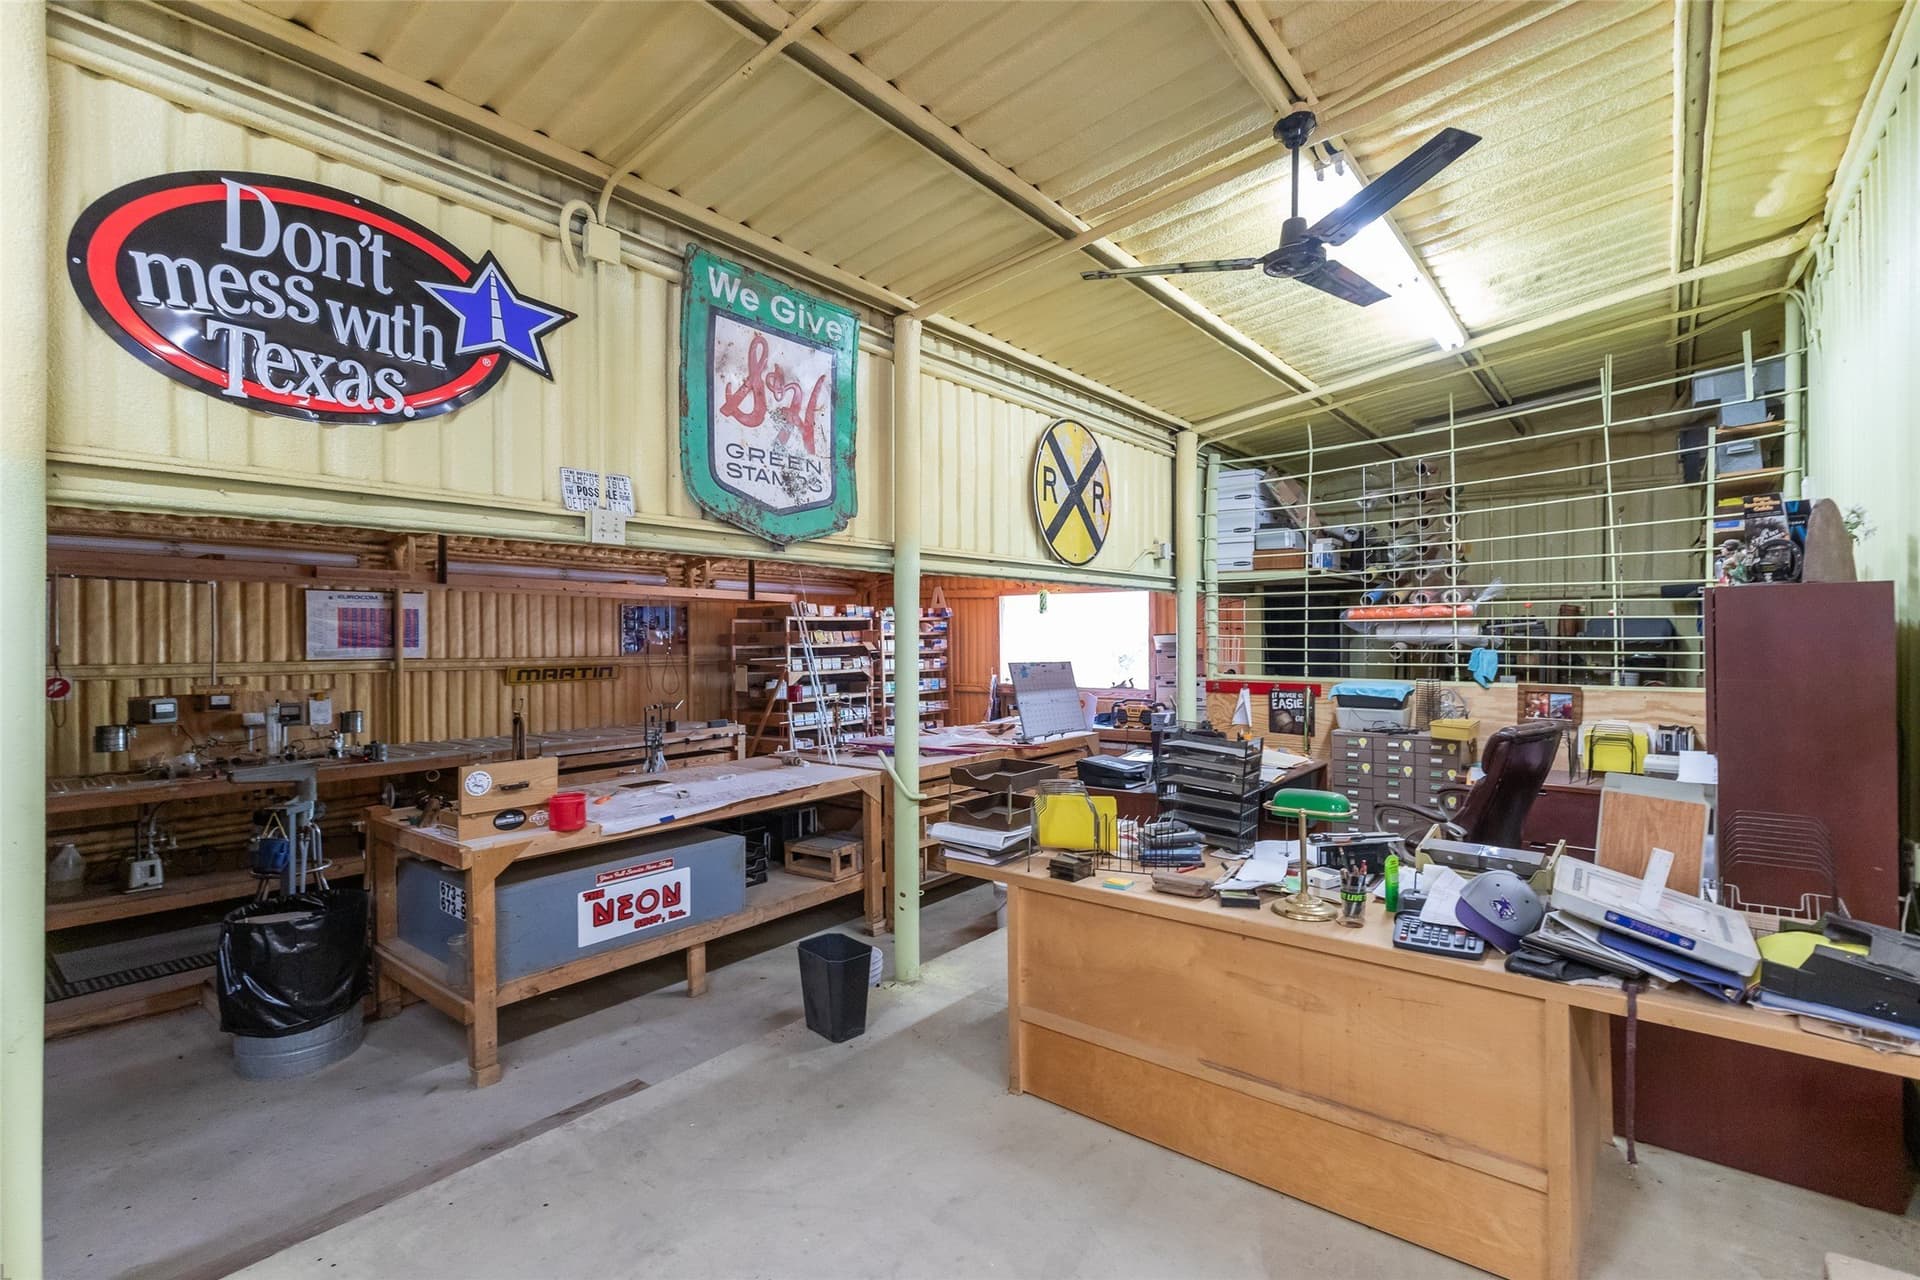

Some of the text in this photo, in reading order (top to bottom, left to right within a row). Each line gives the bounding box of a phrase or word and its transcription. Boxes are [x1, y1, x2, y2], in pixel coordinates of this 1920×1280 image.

[220, 177, 396, 296] Don't
[128, 249, 447, 371] mess with
[707, 265, 843, 342] We Give
[206, 319, 416, 418] Texas.
[725, 443, 823, 475] GREEN
[573, 476, 629, 491] IMPOSIBLE
[577, 485, 618, 500] POSSLE
[1043, 465, 1105, 515] R R
[517, 667, 613, 681] MARTIN
[1272, 698, 1313, 709] EASIE.
[583, 889, 605, 902] THE
[593, 882, 681, 927] NEON
